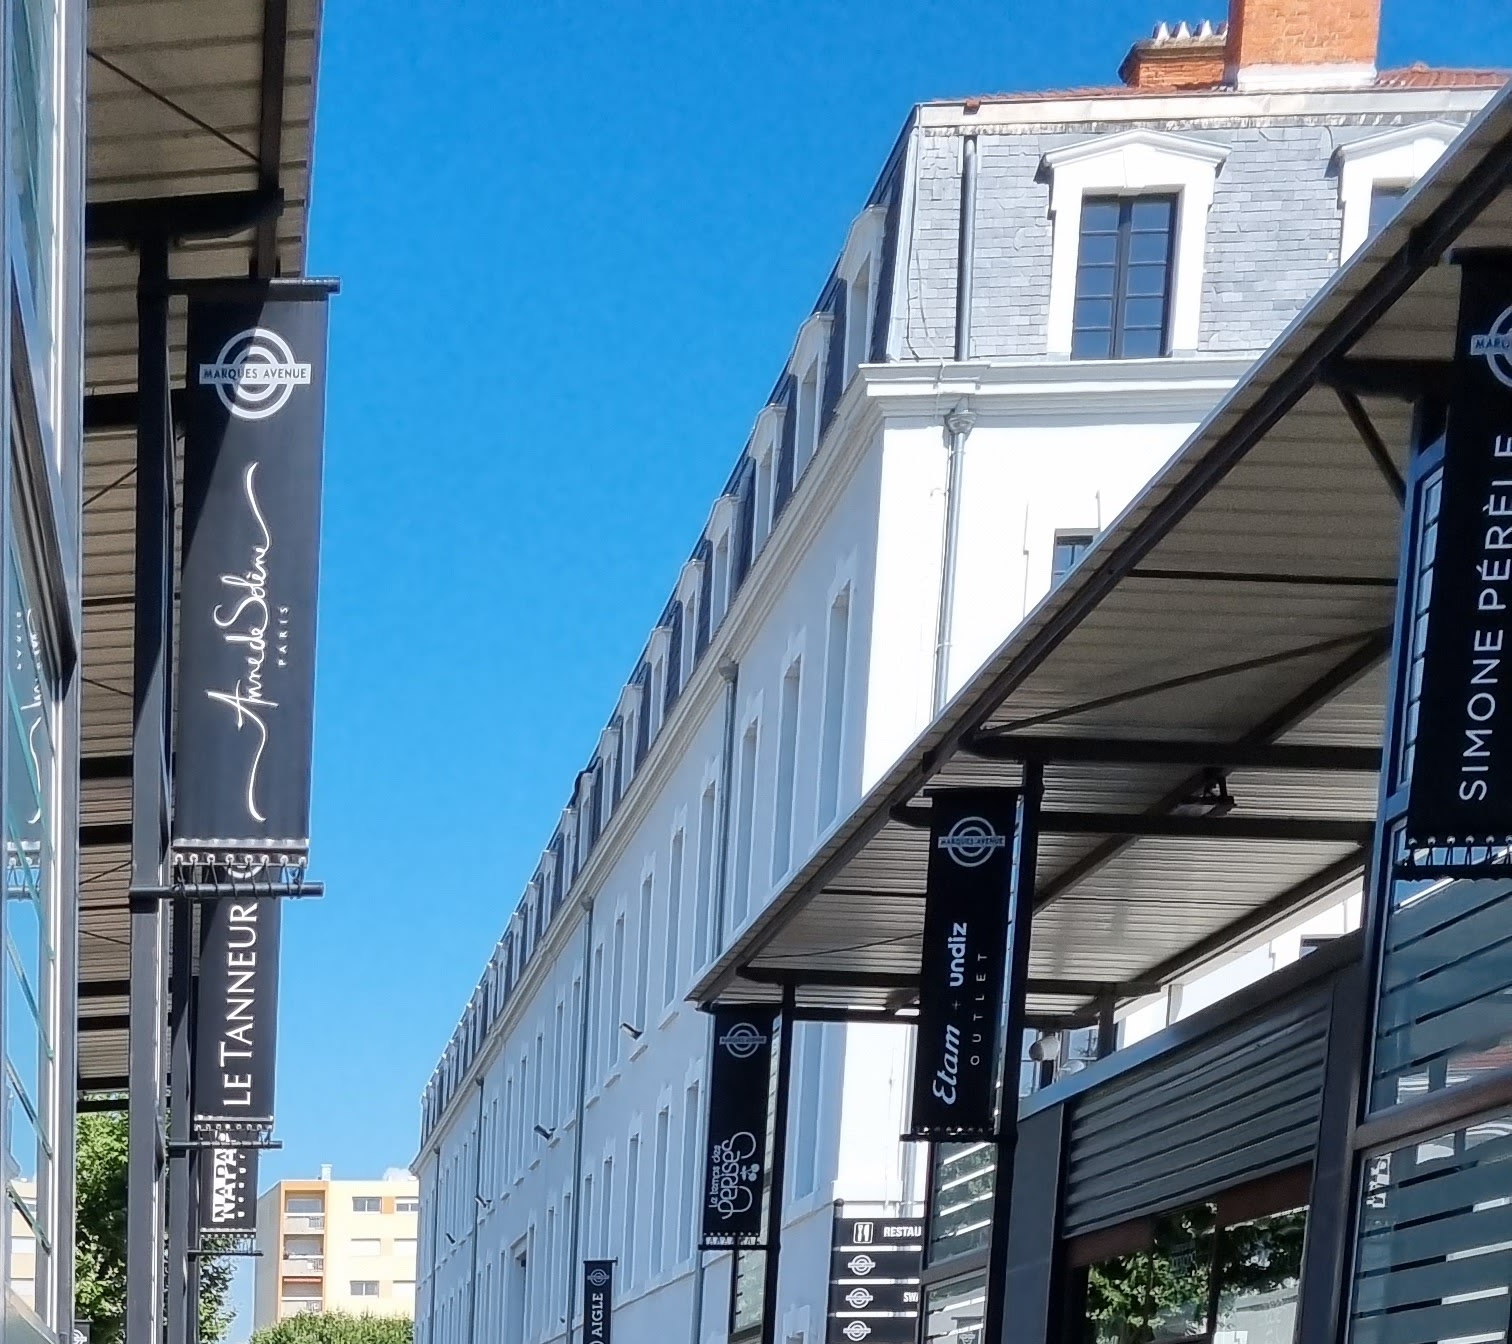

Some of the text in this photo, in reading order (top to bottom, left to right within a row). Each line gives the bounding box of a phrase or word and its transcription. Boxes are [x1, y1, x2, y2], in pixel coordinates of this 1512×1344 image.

[203, 368, 307, 381] MARQUES AVENUE
[277, 605, 290, 667] PARIS
[1457, 629, 1504, 804] SIMONE
[220, 902, 258, 1107] LE TANNEUR
[932, 1024, 961, 1105] Etam
[947, 921, 968, 988] undiz
[969, 952, 989, 1067] OUTLET
[213, 1142, 237, 1223] NAPA
[883, 1226, 922, 1238] RESTAU
[591, 1292, 604, 1338] AIGLE
